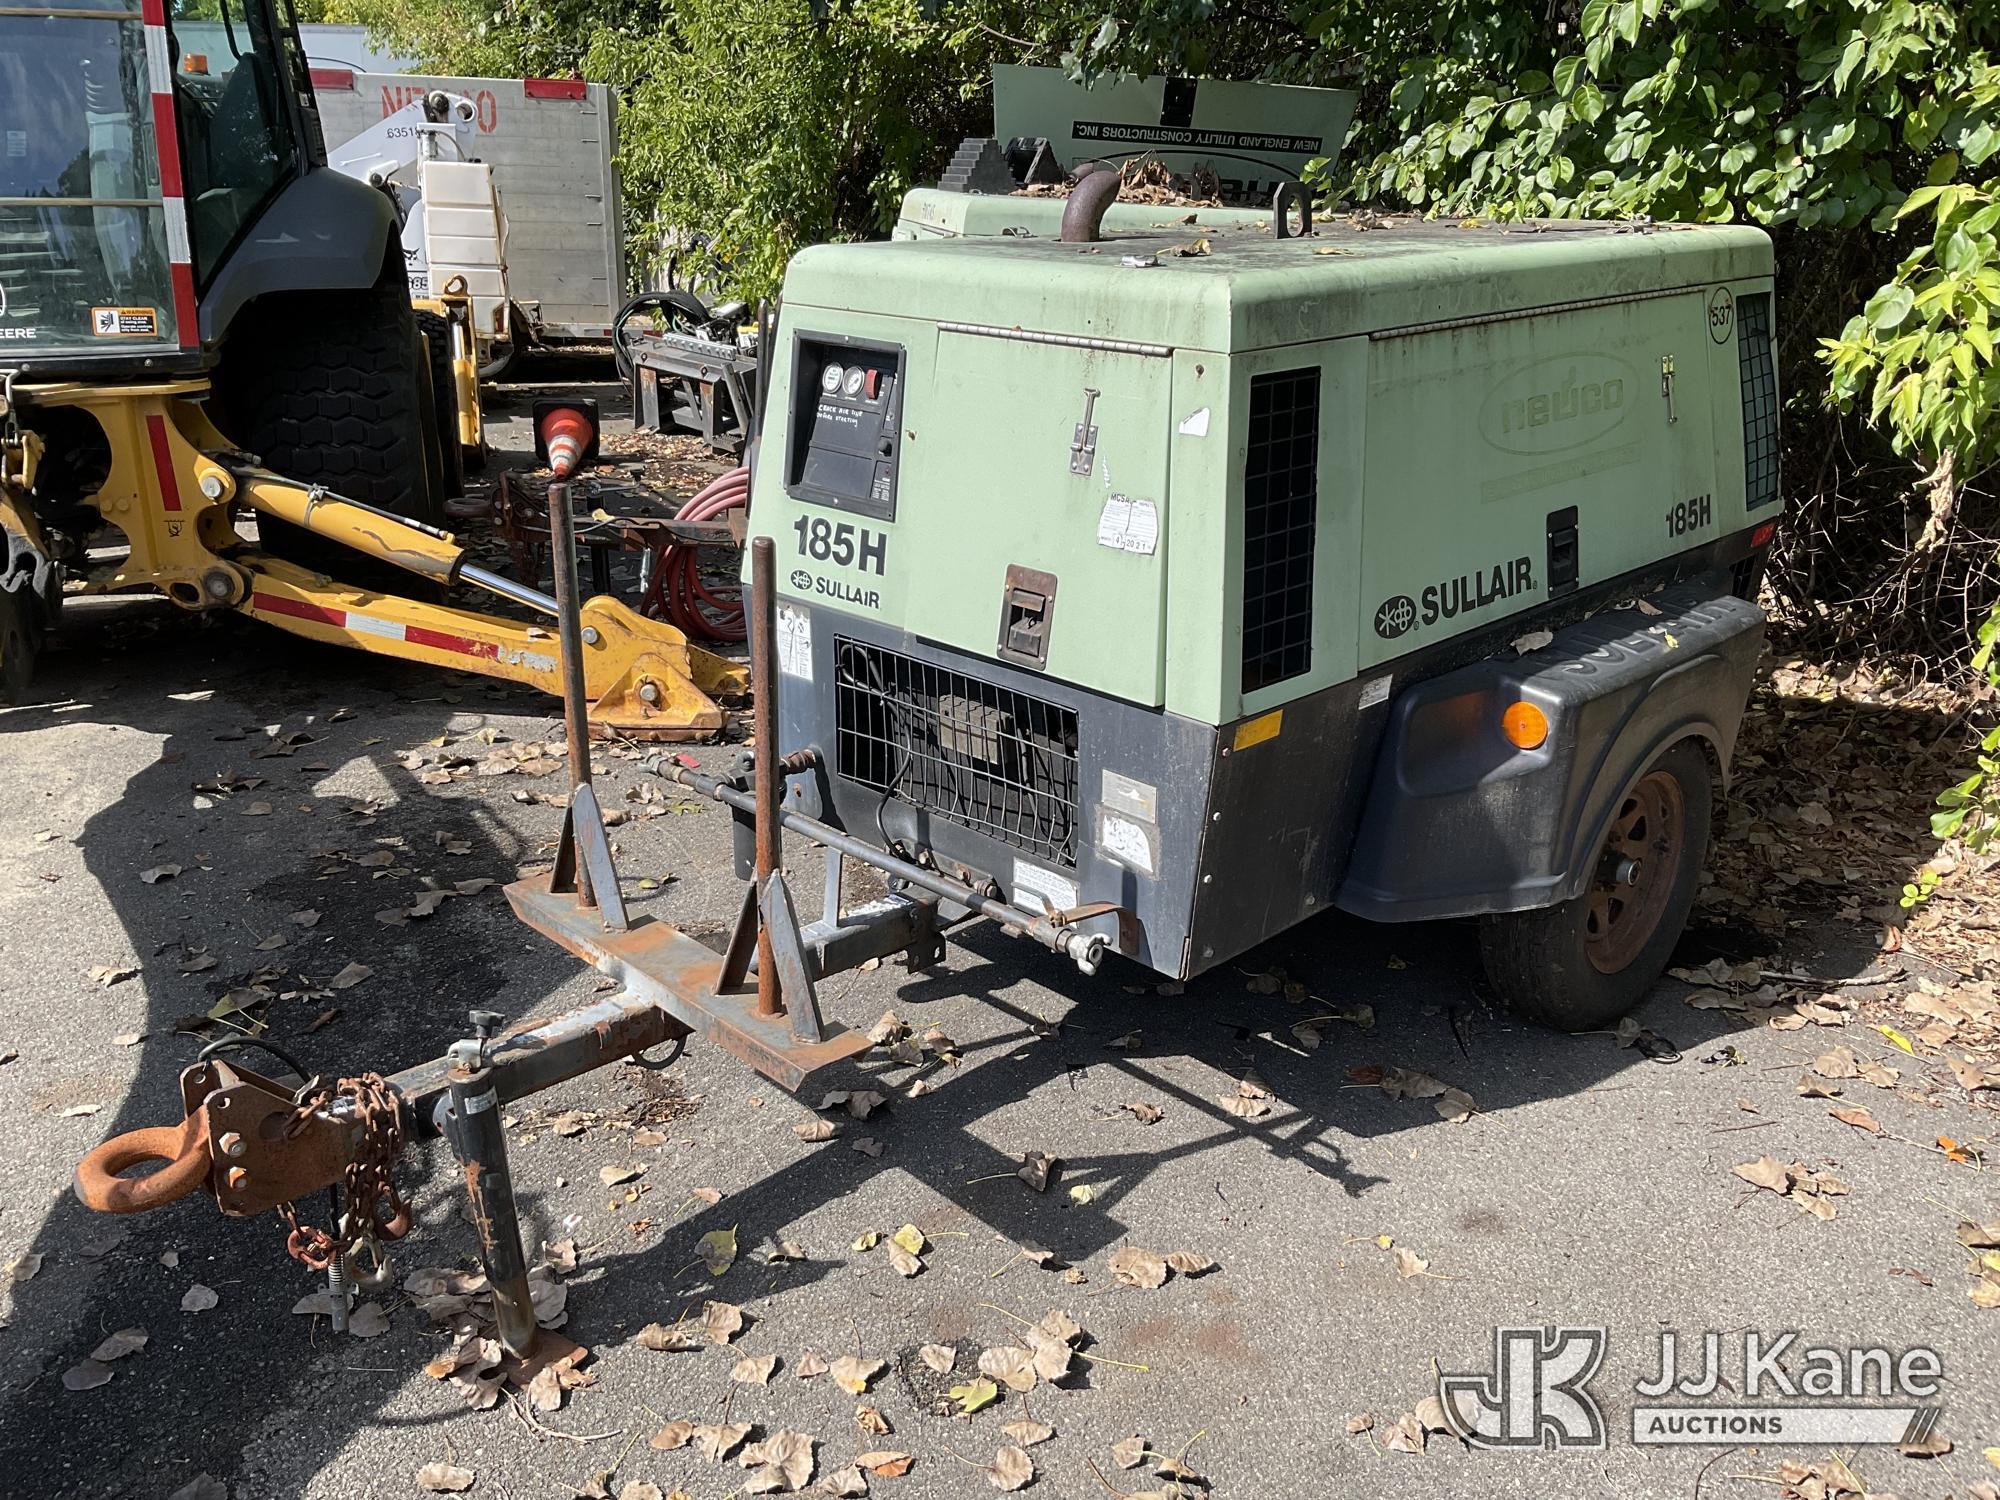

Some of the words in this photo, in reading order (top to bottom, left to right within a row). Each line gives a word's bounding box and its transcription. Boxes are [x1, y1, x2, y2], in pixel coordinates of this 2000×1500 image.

[1076, 124, 1098, 136] INC.
[1102, 126, 1192, 143] CONSTRUCTORS
[1196, 133, 1235, 146] UTILITY
[1239, 136, 1290, 149] ENGLAND
[1294, 138, 1319, 151] NEW
[1710, 303, 1731, 327] 537
[1666, 494, 1711, 537] 185H
[794, 514, 887, 576] 185H
[816, 577, 880, 609] SULLAIR
[1422, 556, 1532, 626] SULLAIR
